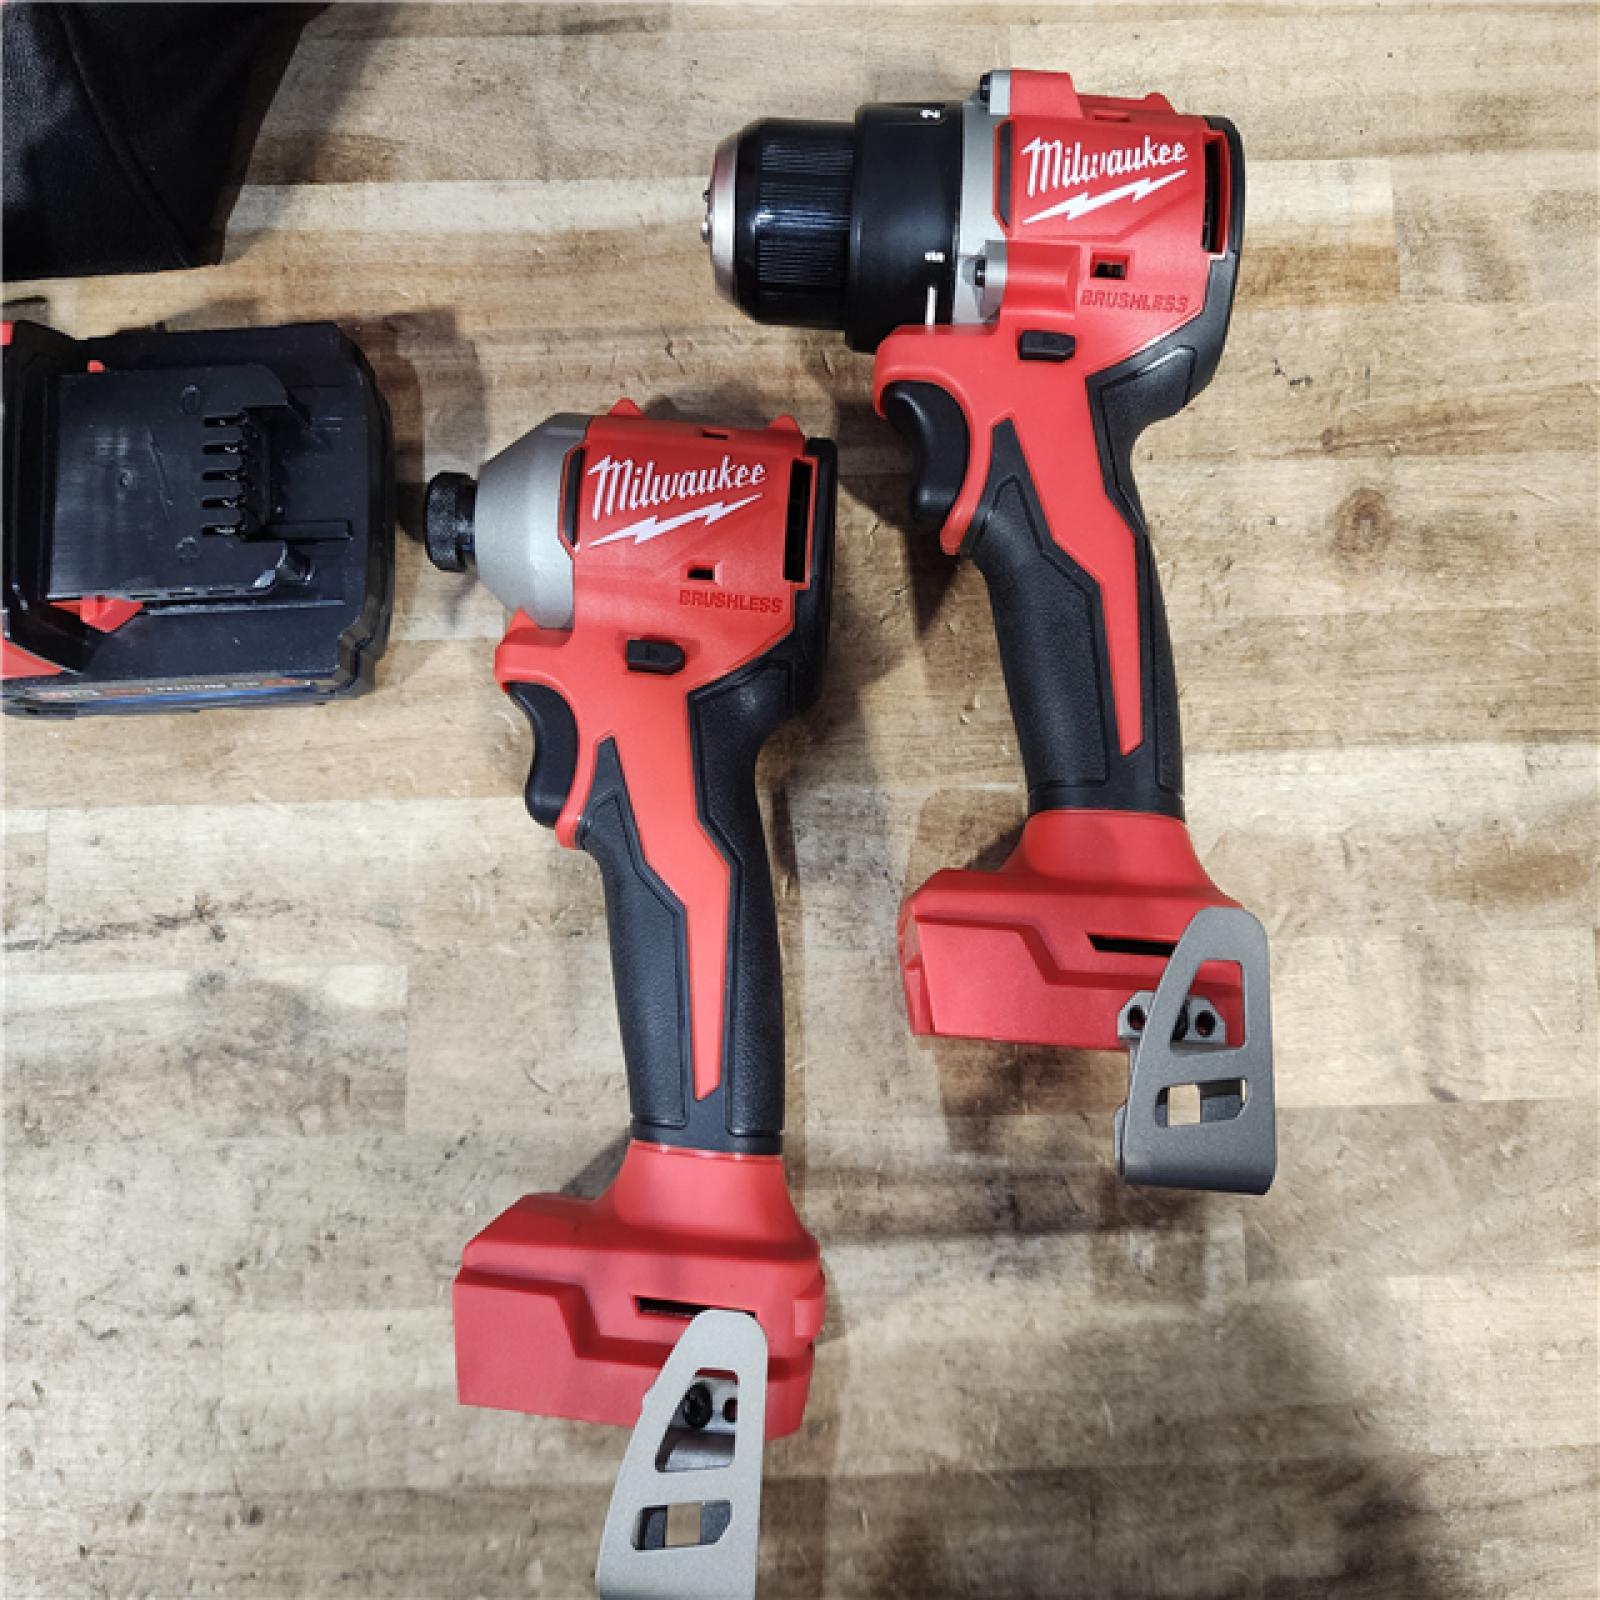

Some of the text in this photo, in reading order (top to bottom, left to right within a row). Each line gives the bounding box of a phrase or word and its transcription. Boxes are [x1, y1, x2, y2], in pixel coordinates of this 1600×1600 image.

[1021, 135, 1188, 198] Milwaukee
[1080, 289, 1188, 313] BRUSHLESS
[587, 454, 766, 521] Milwaukee
[679, 589, 783, 613] BRUSHLESS
